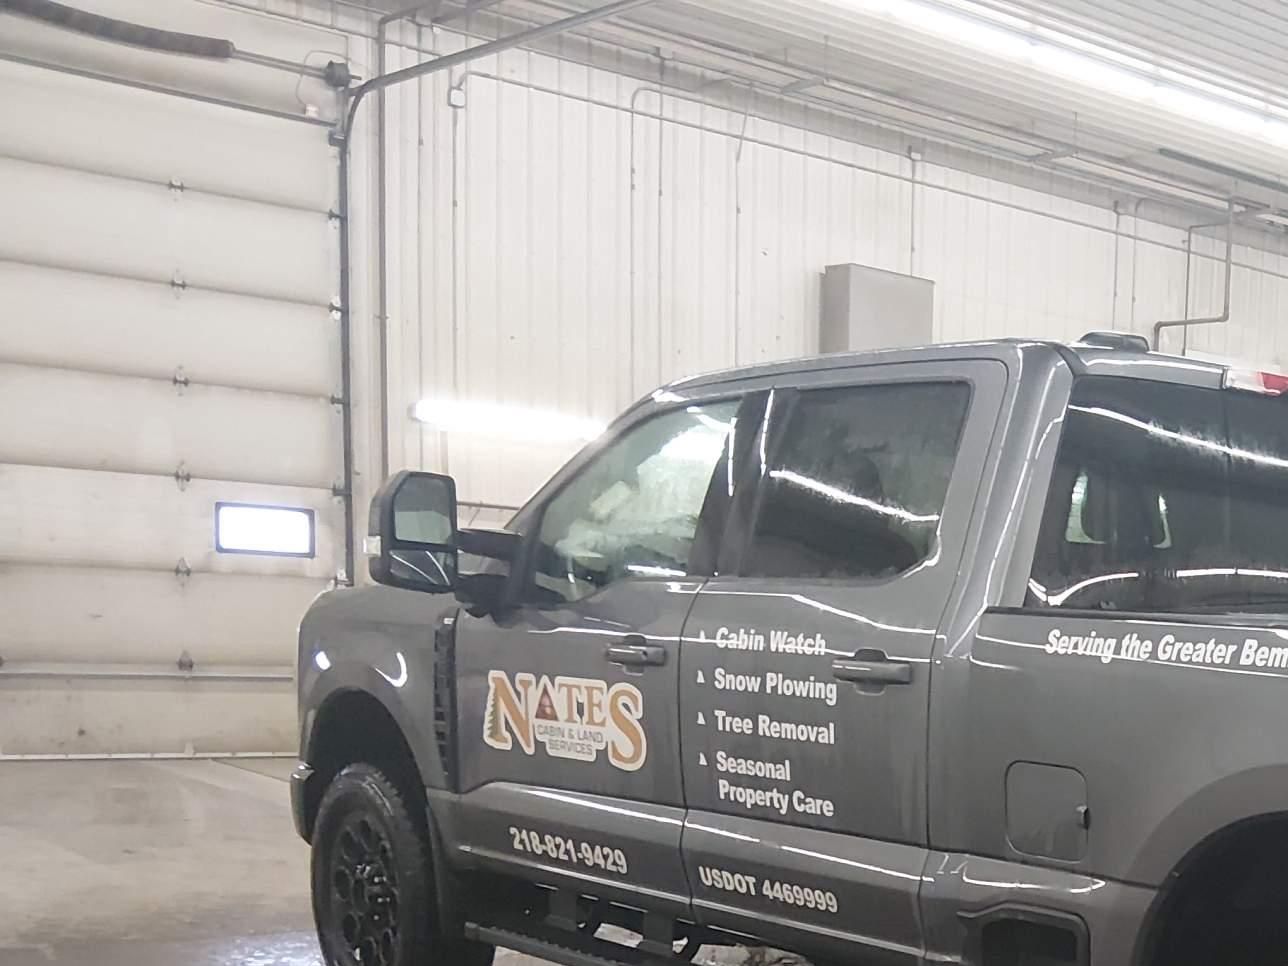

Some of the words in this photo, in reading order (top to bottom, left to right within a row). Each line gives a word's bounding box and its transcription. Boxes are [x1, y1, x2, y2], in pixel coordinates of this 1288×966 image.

[716, 627, 764, 651] Cabin
[770, 630, 826, 656] Watch
[1046, 629, 1116, 663] Serving
[1121, 633, 1152, 659] the
[1157, 635, 1238, 665] Greater
[714, 667, 761, 693] Snow
[766, 672, 837, 706] Plowing
[537, 724, 565, 739] CABIN
[577, 729, 603, 744] LAND
[714, 709, 753, 734] Tree
[758, 714, 835, 744] Removal
[549, 739, 593, 756] SERVICES
[716, 751, 791, 781] Seasonal
[719, 779, 789, 815] Property
[792, 790, 834, 816] Care
[509, 827, 628, 874] 218-821-9429
[699, 866, 757, 896] USDOT
[762, 879, 838, 913] 4469999
